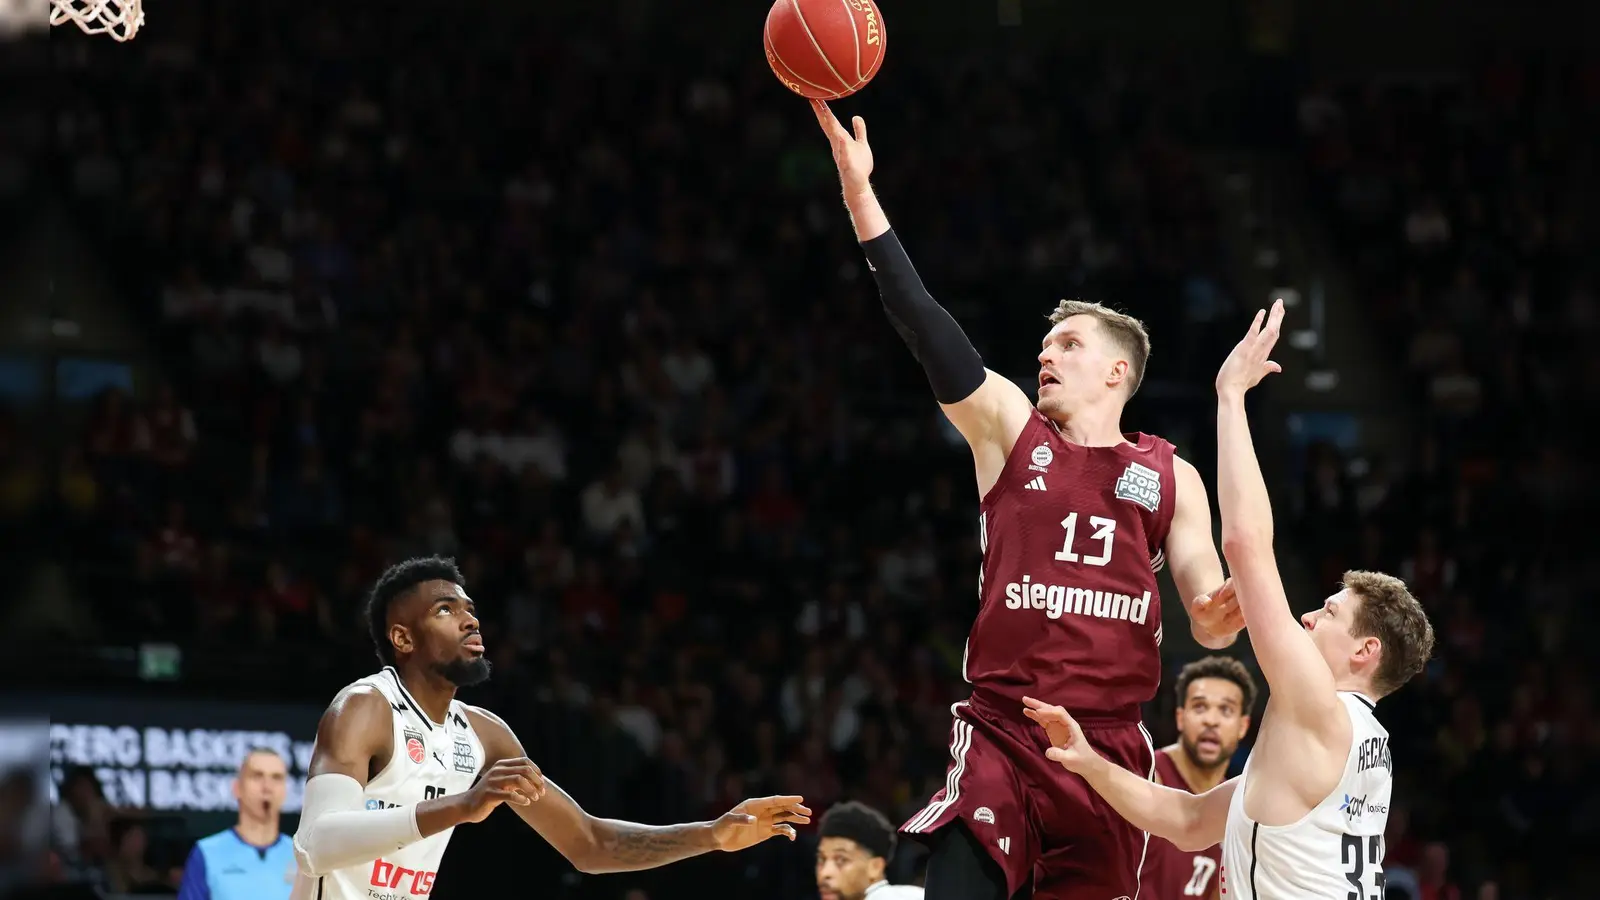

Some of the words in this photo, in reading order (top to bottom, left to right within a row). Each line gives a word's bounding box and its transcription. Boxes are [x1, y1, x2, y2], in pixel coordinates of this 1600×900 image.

[1118, 481, 1160, 507] FOUR
[1127, 471, 1159, 491] TOP
[1054, 511, 1117, 567] 13
[1005, 575, 1152, 625] siegmund
